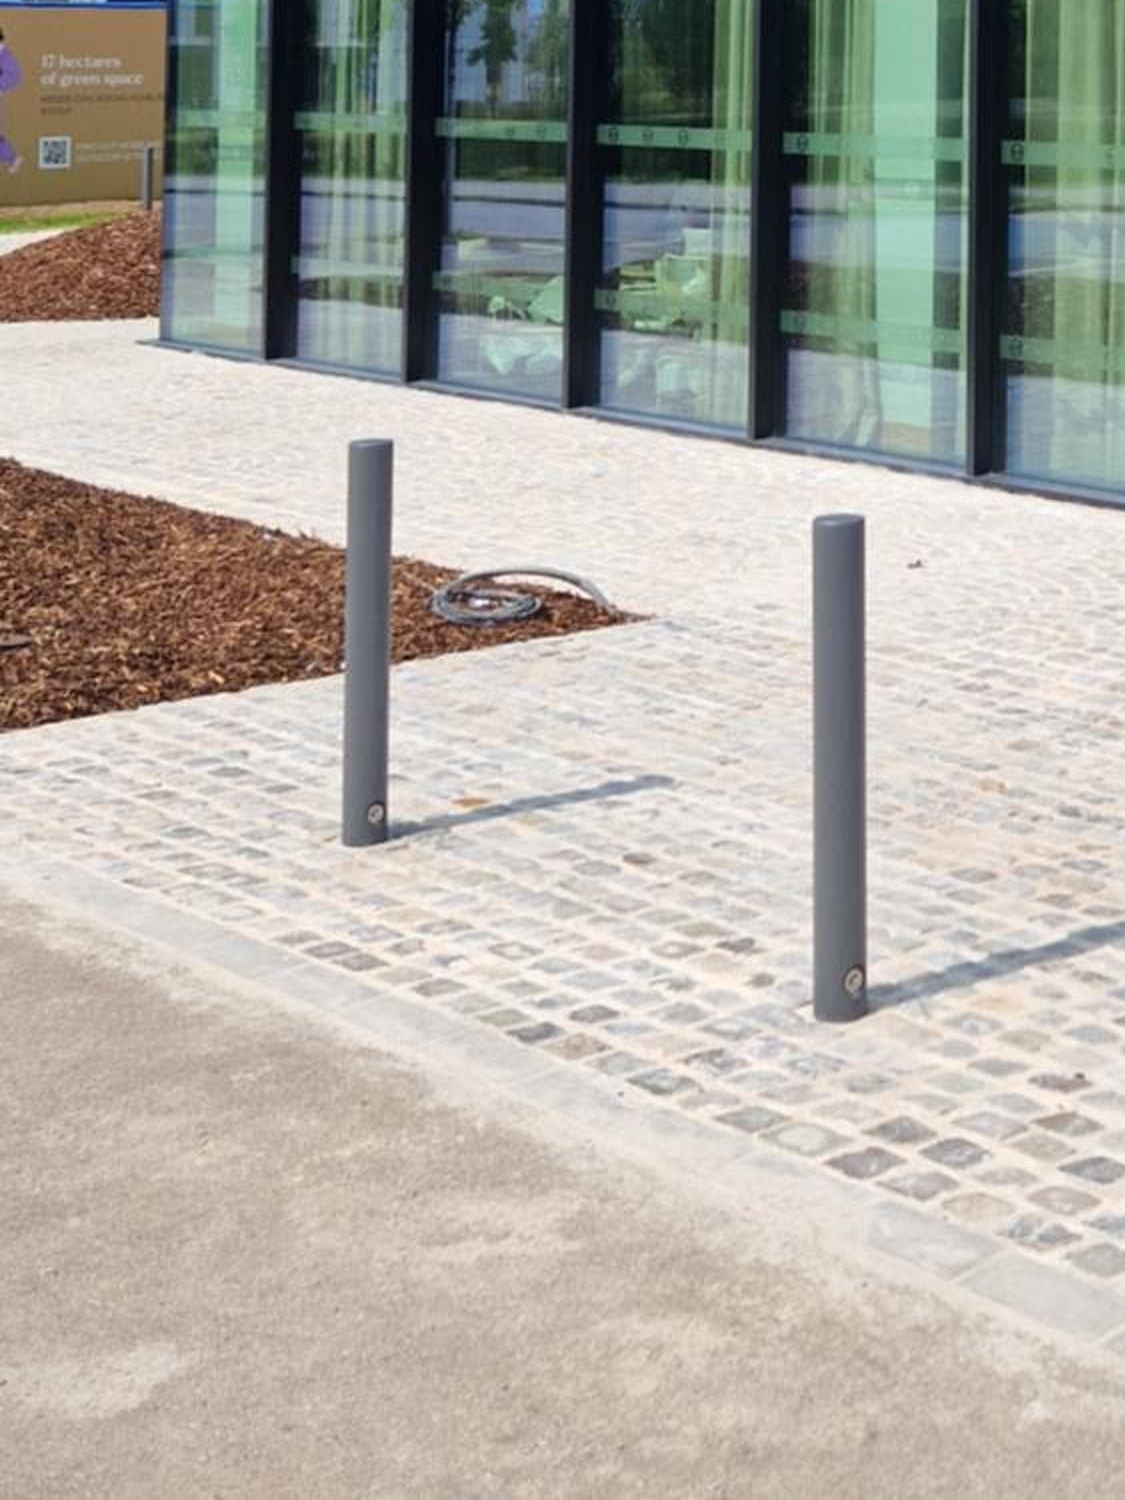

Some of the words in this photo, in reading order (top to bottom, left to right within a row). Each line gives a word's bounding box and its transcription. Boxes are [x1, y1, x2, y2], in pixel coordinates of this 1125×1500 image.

[60, 55, 121, 69] hectares
[41, 72, 57, 85] of
[60, 74, 101, 88] green
[104, 74, 143, 88] space
